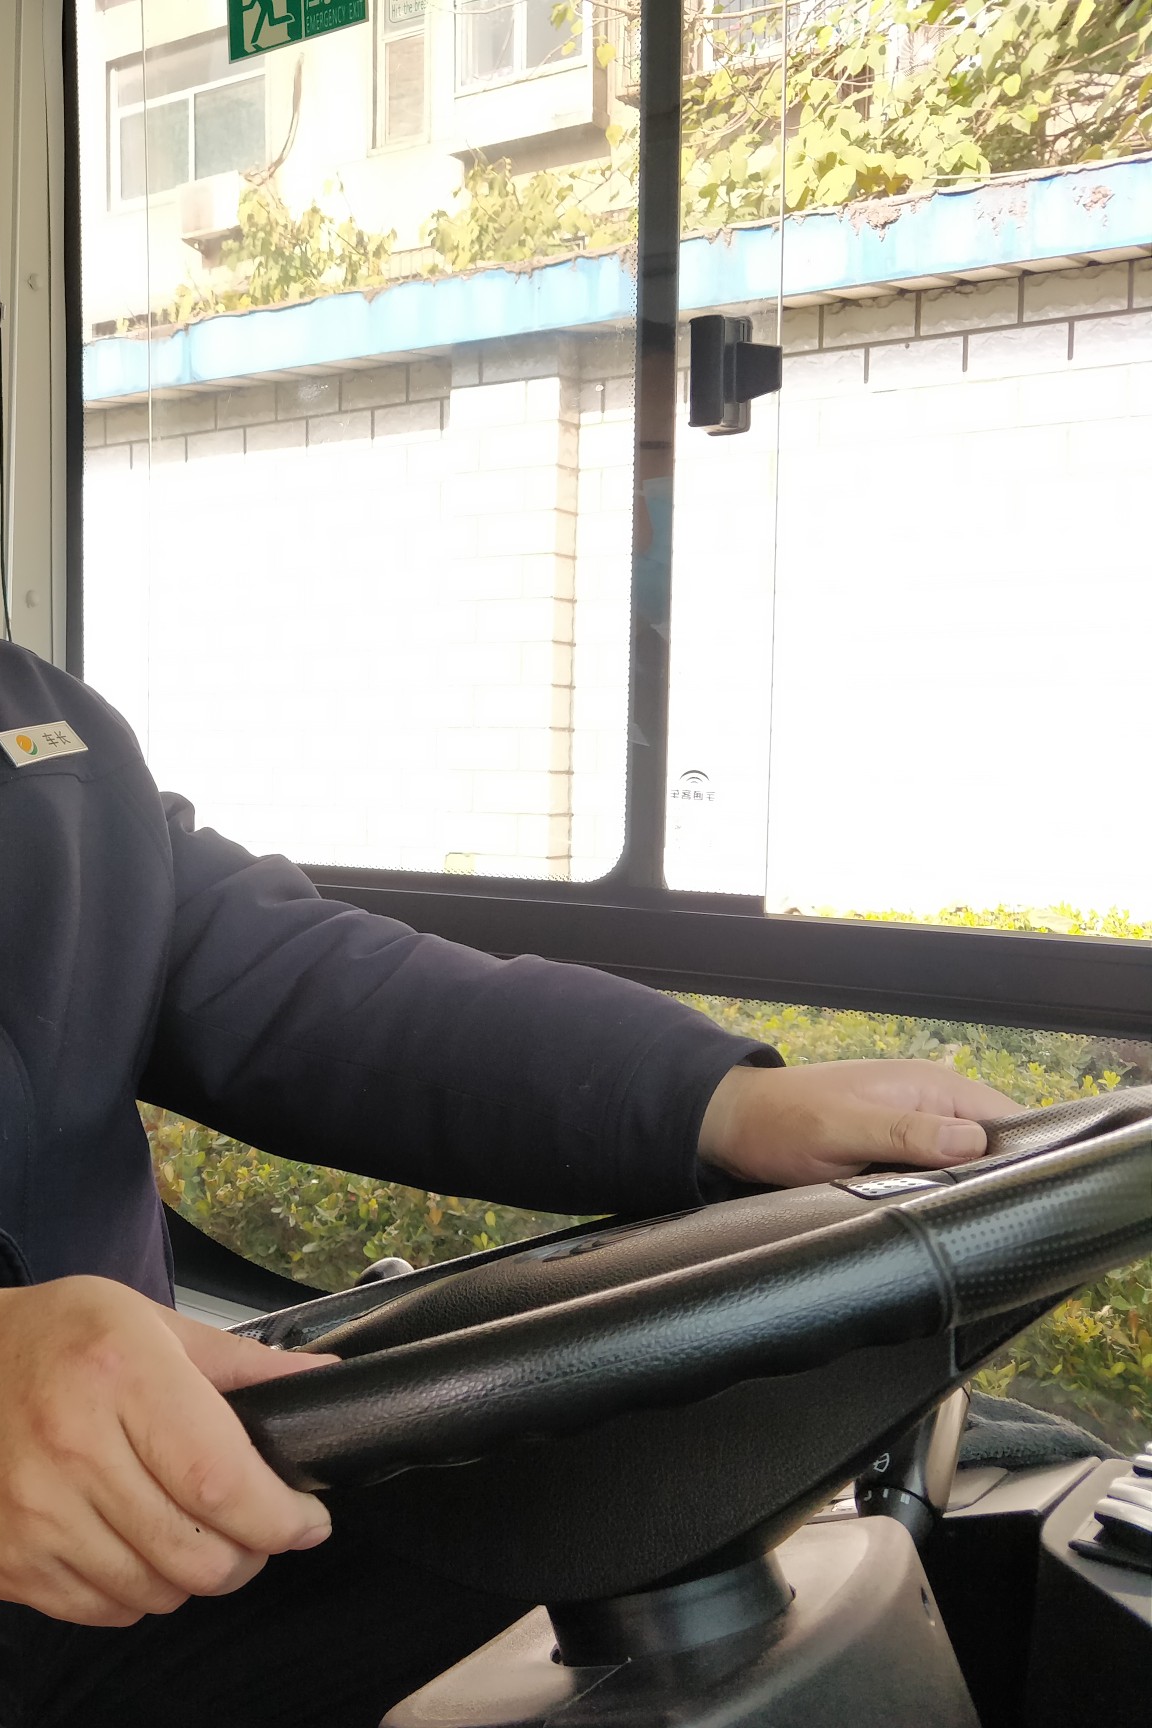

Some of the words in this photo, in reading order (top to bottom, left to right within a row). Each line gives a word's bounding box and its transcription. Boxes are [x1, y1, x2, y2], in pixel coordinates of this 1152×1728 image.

[306, 5, 346, 33] EMERGENCY
[349, 0, 363, 19] EXIT
[42, 730, 71, 748] 车长
